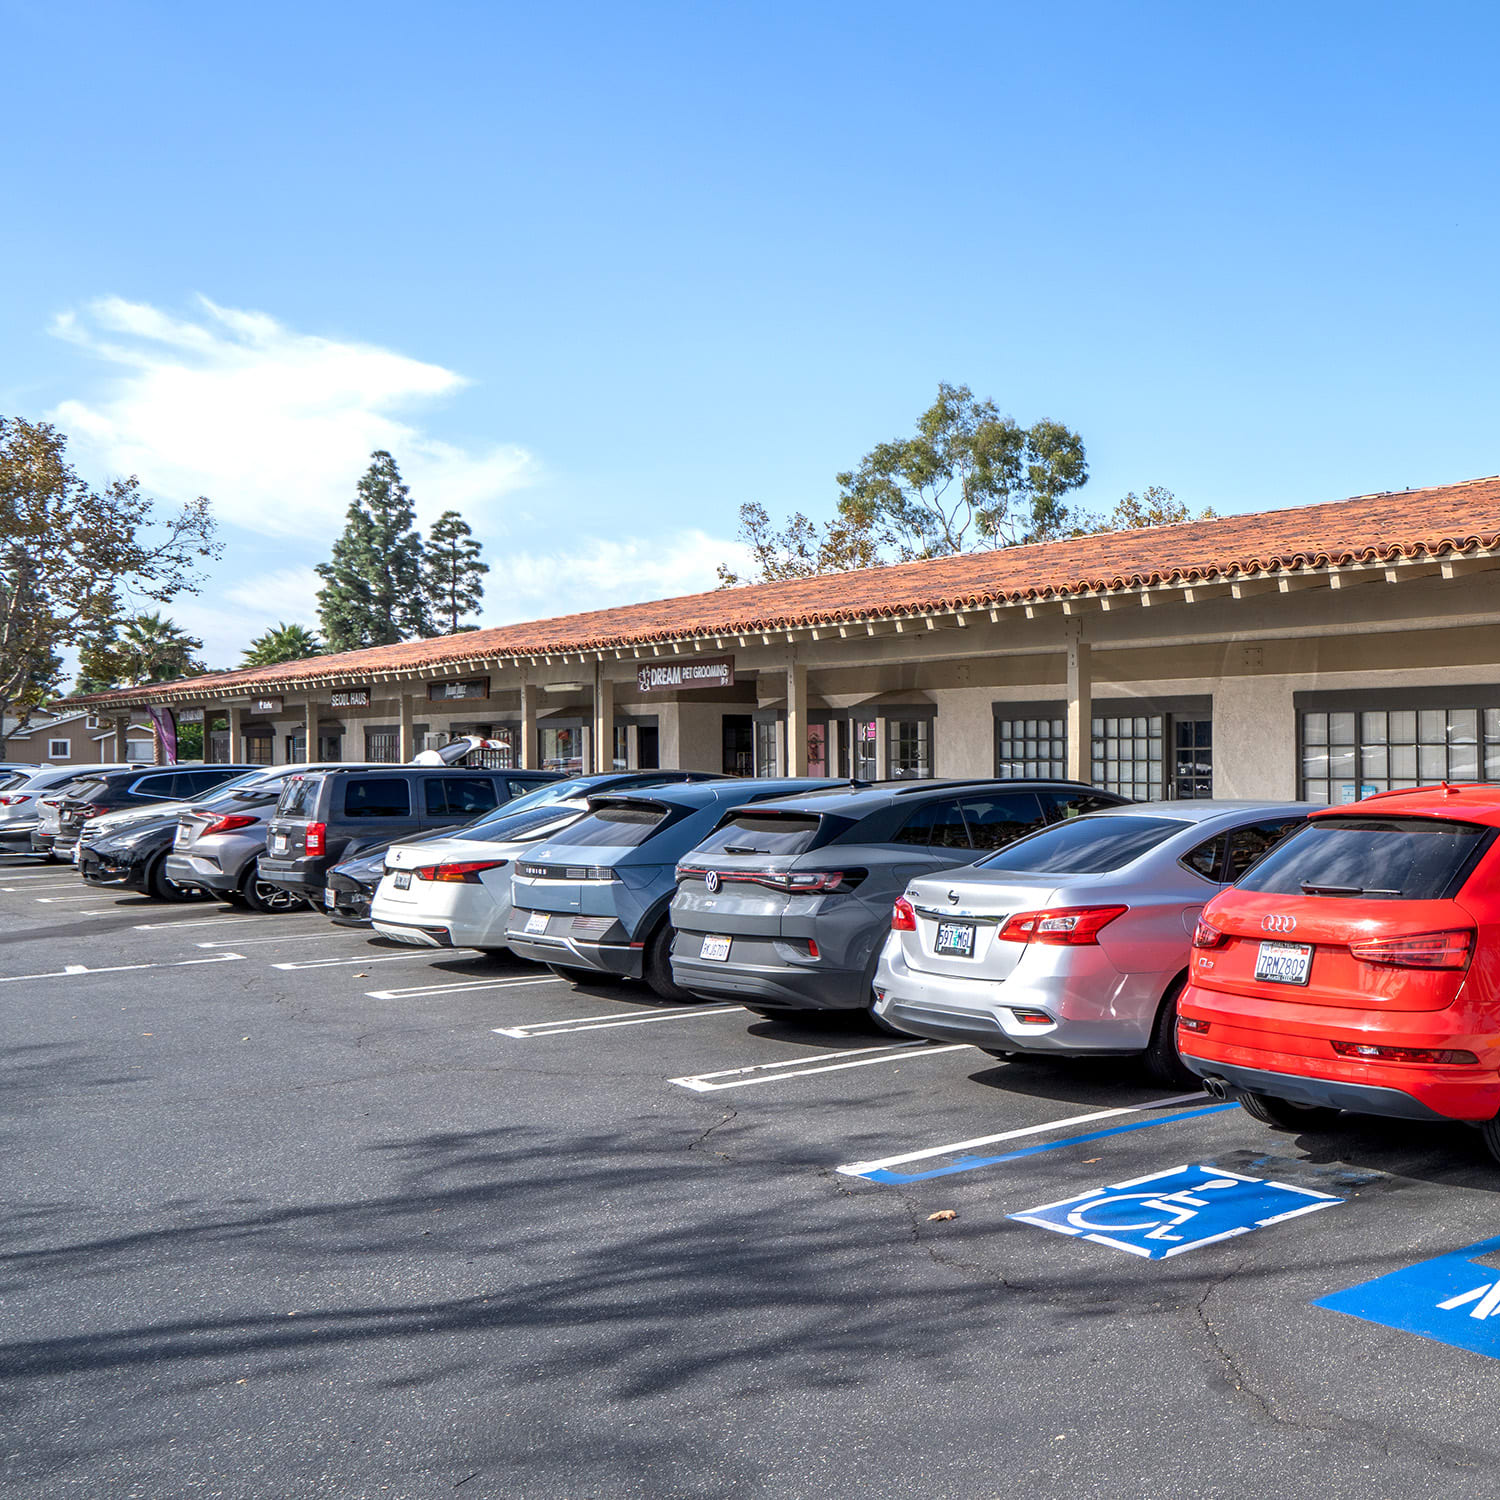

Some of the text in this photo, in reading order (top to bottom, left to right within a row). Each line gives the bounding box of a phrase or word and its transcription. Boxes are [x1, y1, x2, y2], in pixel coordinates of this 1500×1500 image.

[650, 664, 729, 686] DREAM PET GROOMING
[331, 692, 367, 707] SEOUL HAUS
[1260, 956, 1306, 976] 7RMZ809
